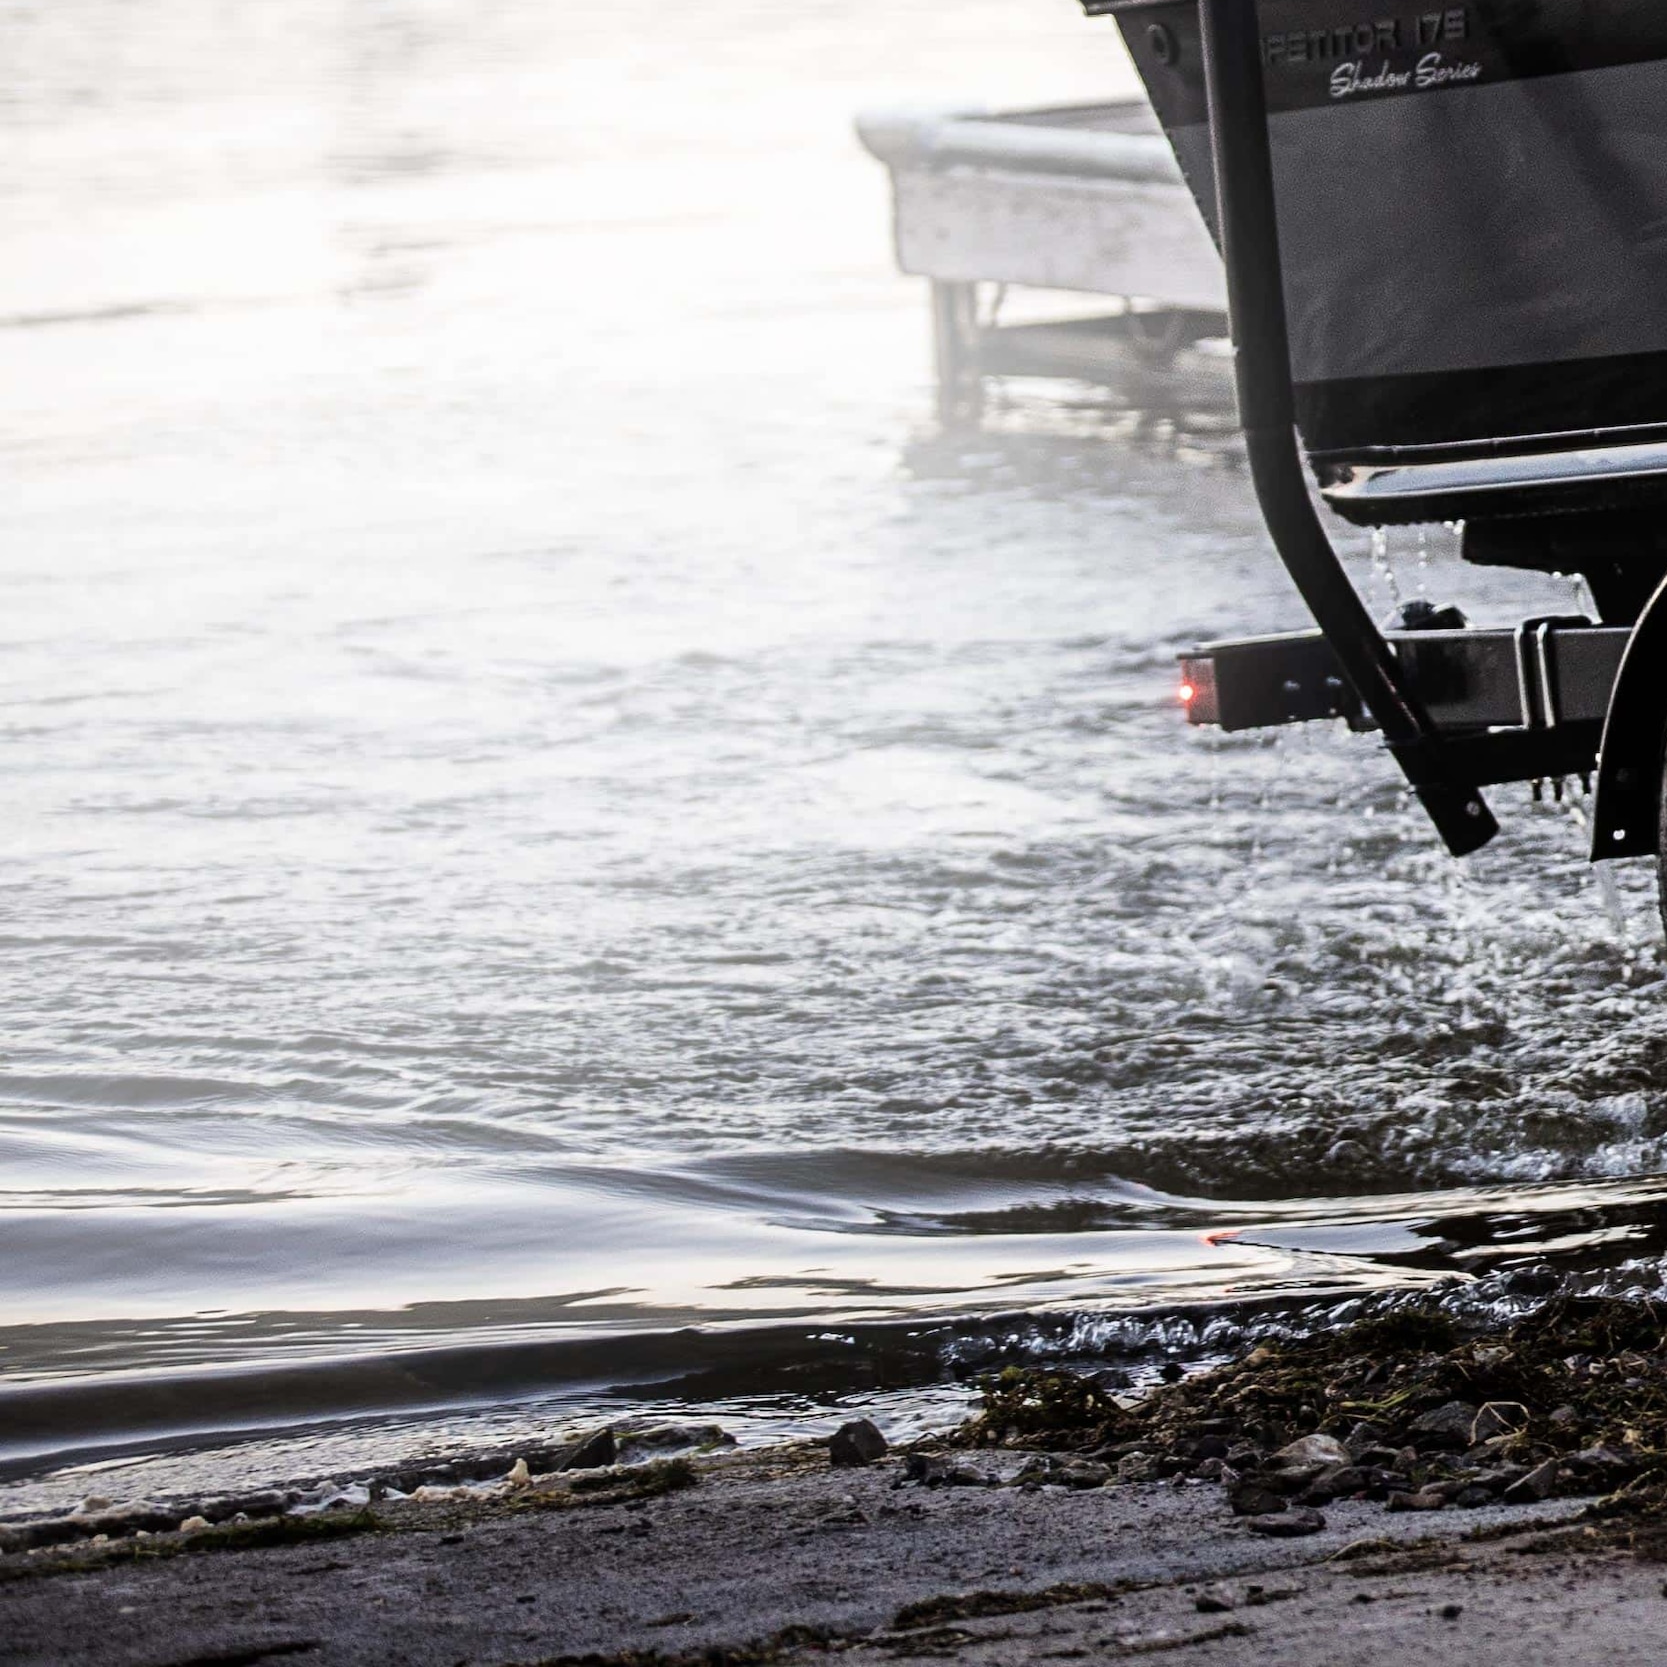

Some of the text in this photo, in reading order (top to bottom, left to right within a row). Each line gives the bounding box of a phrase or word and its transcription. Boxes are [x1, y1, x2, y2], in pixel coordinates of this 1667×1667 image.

[1260, 18, 1402, 66] PETITOR
[1329, 51, 1482, 98] Shadow Series
